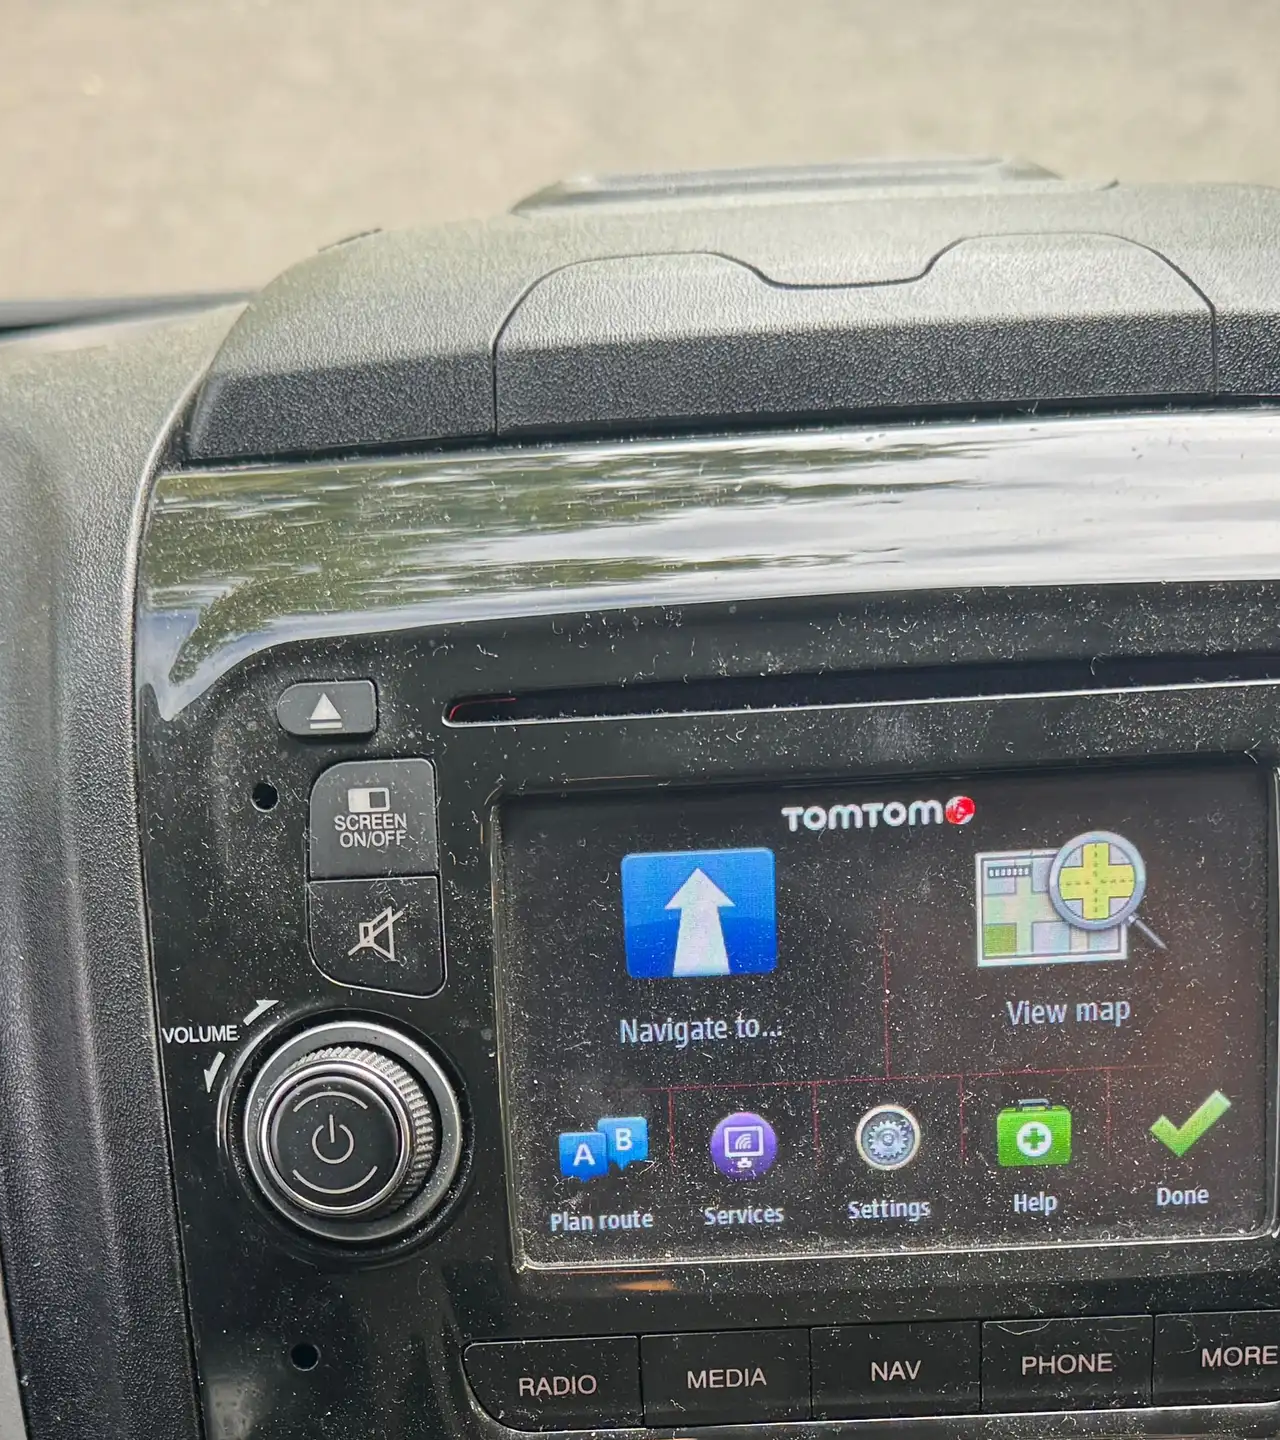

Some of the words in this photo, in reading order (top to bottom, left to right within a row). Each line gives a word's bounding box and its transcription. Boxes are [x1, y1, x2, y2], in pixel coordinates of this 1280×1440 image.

[334, 812, 408, 831] SCREEN
[339, 831, 408, 848] ON/OFF
[1006, 1000, 1070, 1026] View
[1075, 1001, 1131, 1028] map
[162, 1024, 238, 1044] VOLUME
[620, 1017, 730, 1048] Navigate
[615, 1127, 633, 1151] B
[573, 1143, 596, 1167] A
[1012, 1192, 1057, 1217] Help
[1156, 1184, 1209, 1207] Done
[550, 1211, 593, 1233] Plan
[598, 1209, 654, 1231] route
[704, 1205, 784, 1227] Services
[847, 1197, 931, 1222] Settings
[1020, 1352, 1113, 1376] PHONE
[1200, 1345, 1280, 1368] MORE
[686, 1367, 768, 1390] MEDIA
[870, 1360, 922, 1383] NAV
[518, 1374, 598, 1398] RADIO
